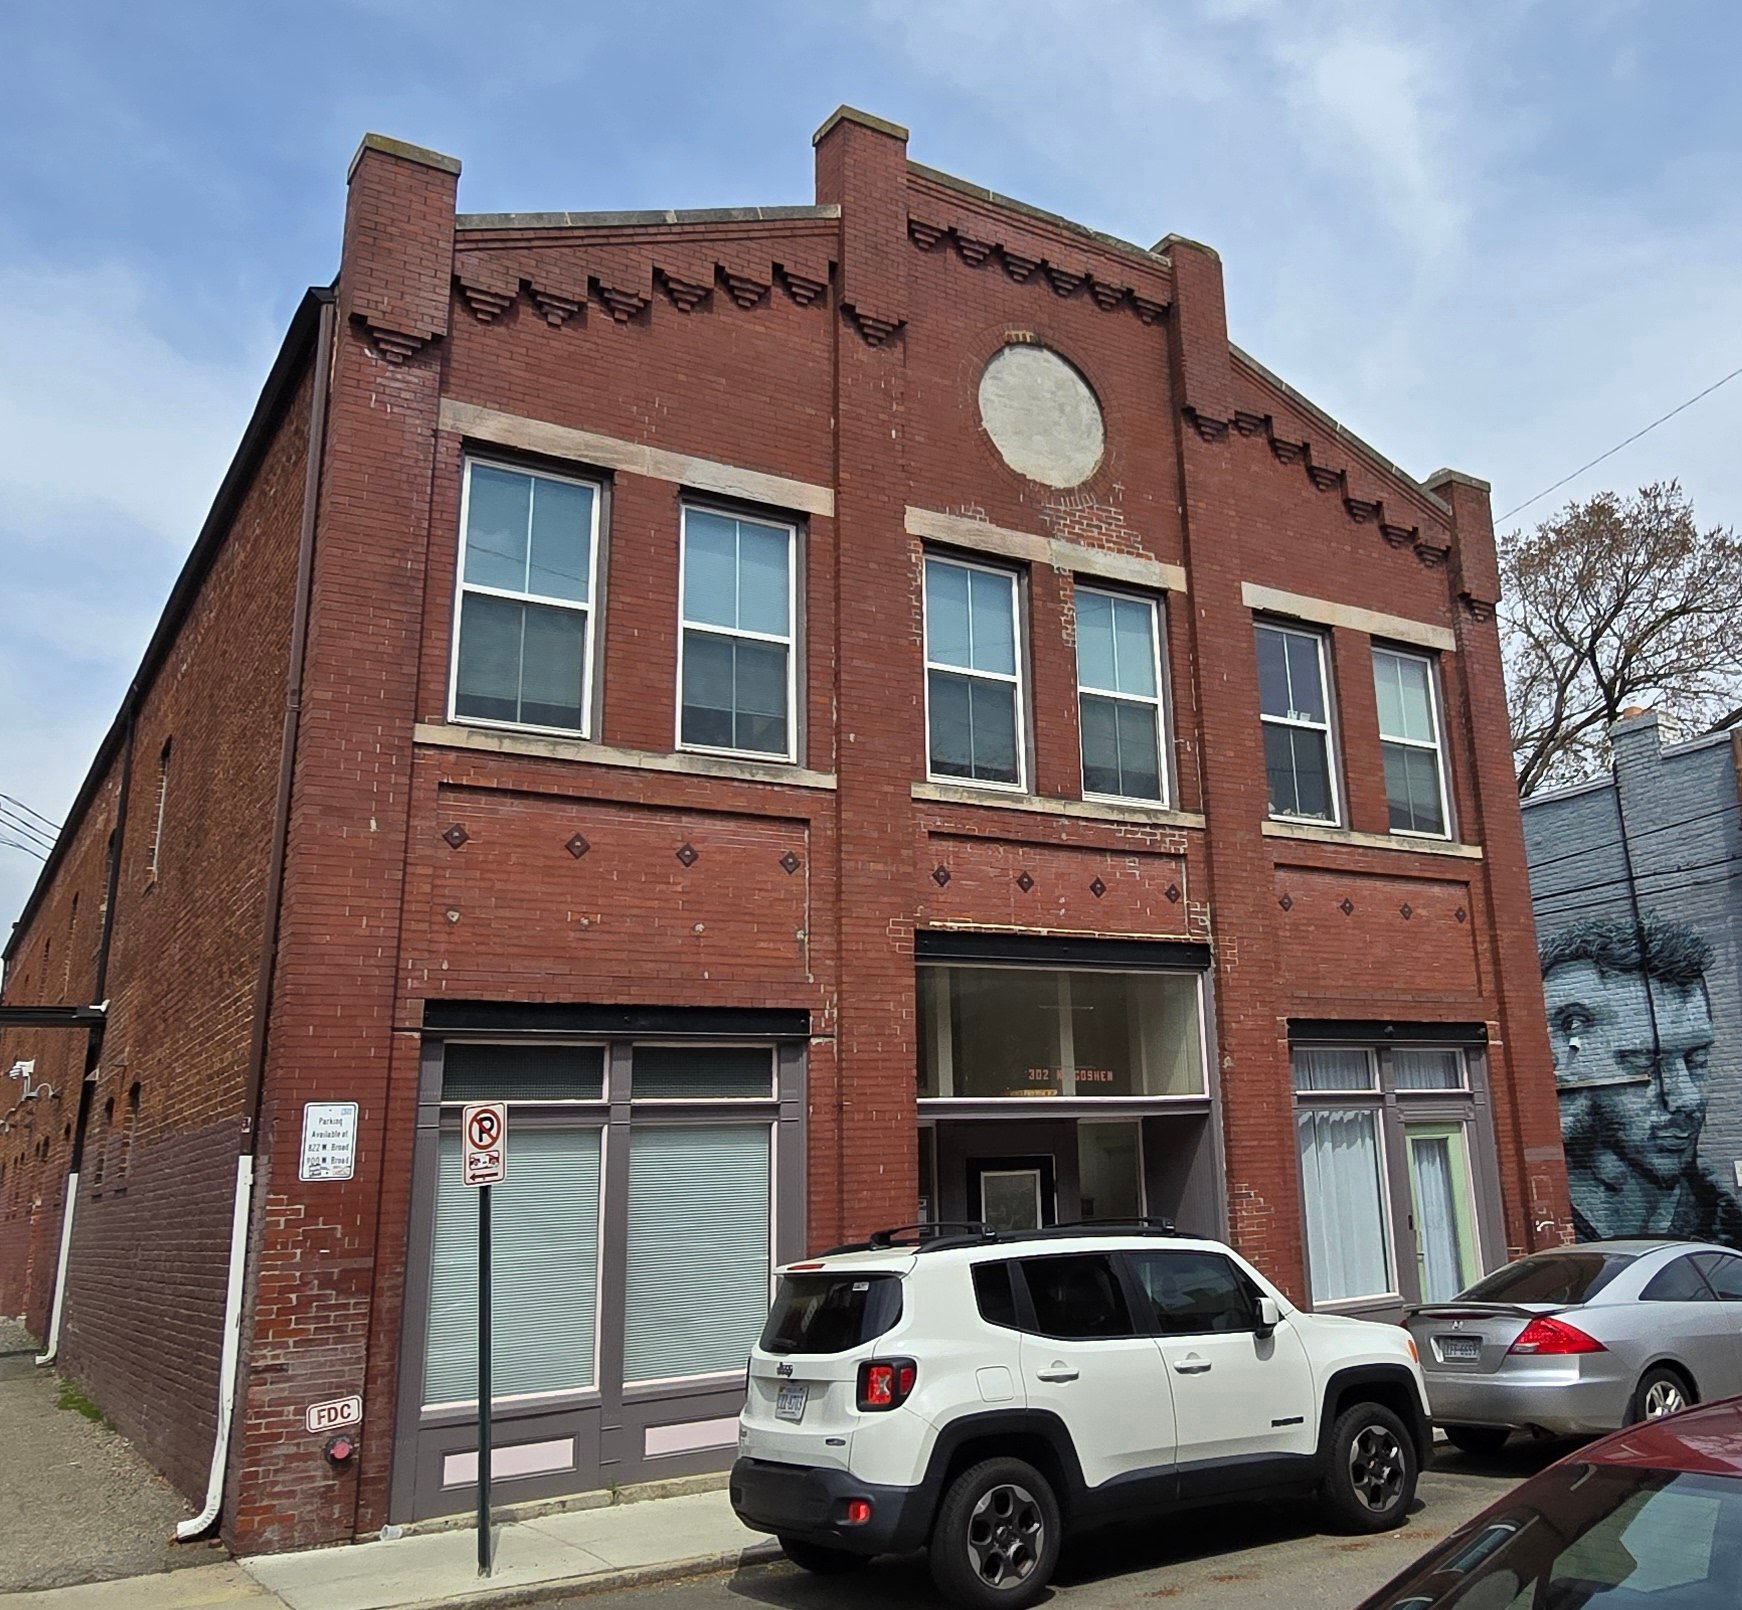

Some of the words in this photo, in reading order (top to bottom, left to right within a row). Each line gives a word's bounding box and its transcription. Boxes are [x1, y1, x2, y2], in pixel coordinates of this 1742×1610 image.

[1028, 1069, 1049, 1080] 302
[1074, 1070, 1113, 1082] GOSHEN
[319, 1117, 343, 1127] Parking
[308, 1144, 320, 1152] 822
[331, 1143, 349, 1151] Broad
[331, 1156, 349, 1164] Broad
[317, 1403, 351, 1426] FDC
